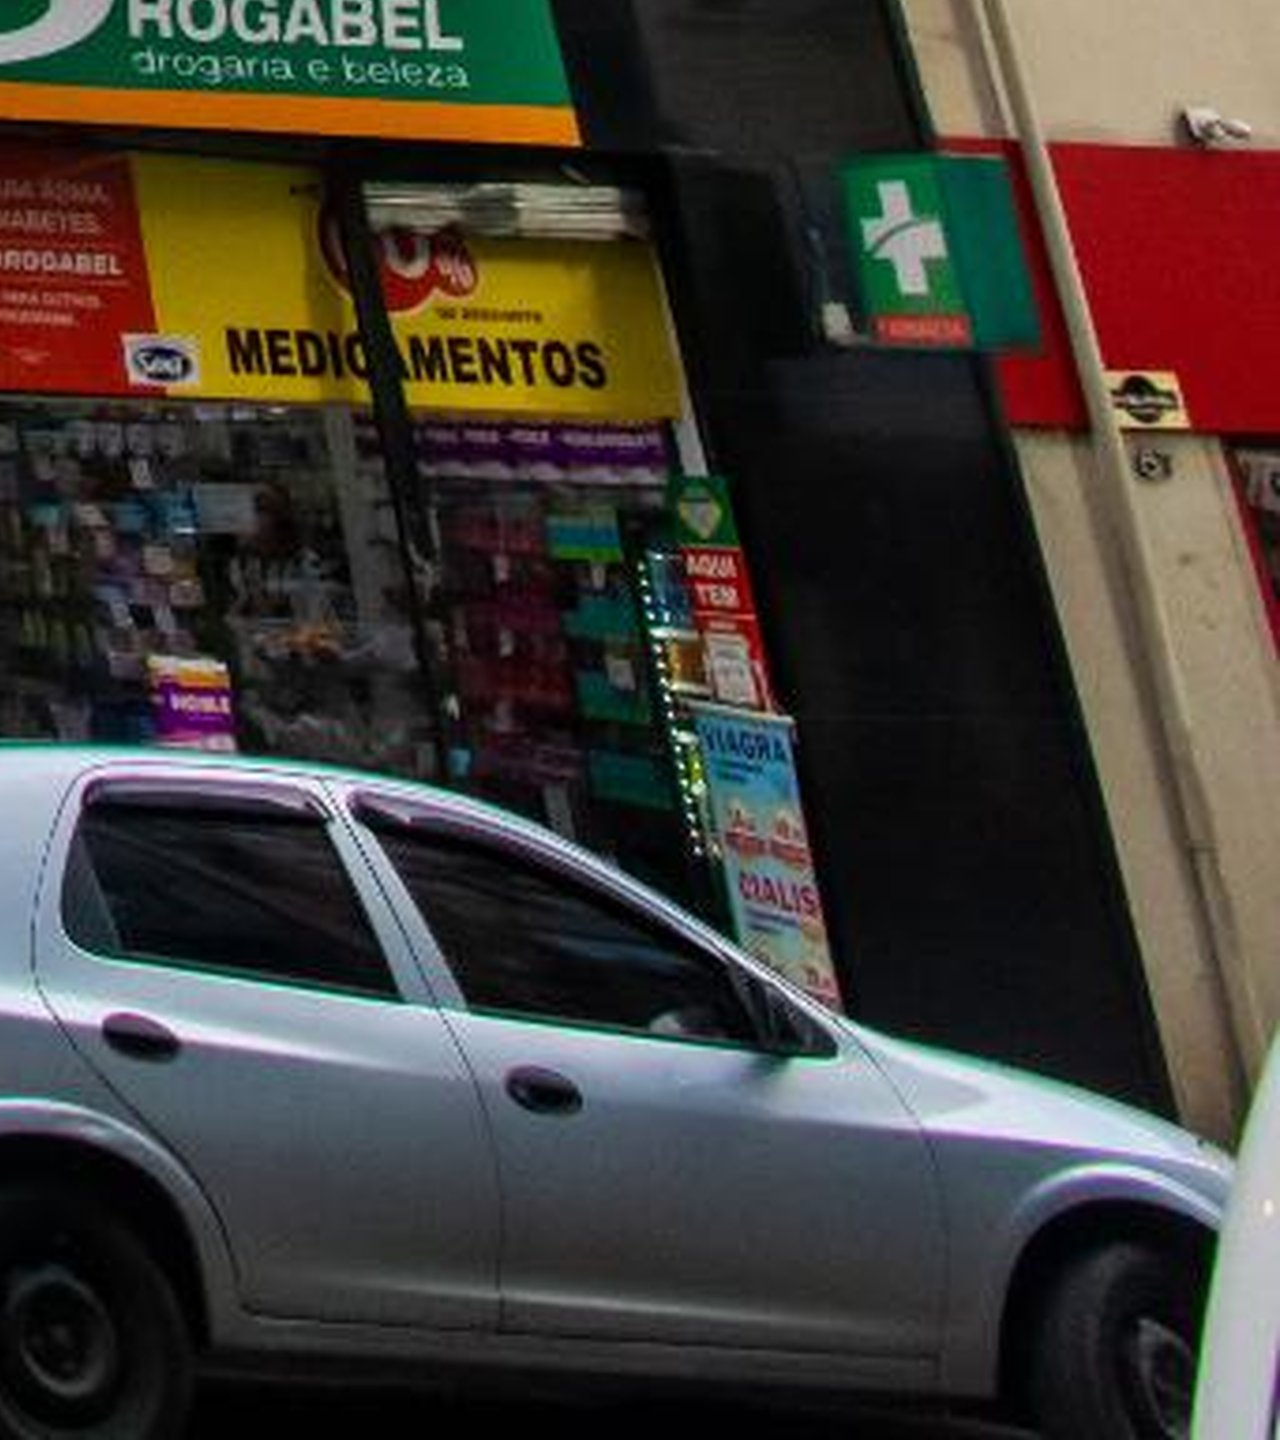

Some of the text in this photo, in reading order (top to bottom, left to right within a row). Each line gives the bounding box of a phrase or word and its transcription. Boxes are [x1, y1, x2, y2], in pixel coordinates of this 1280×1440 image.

[131, 49, 470, 90] drogaria e beleza
[225, 326, 608, 390] MEDICMENTOS
[686, 553, 737, 579] AQUI
[694, 581, 740, 608] TEM
[703, 725, 789, 762] VIAGRA
[739, 871, 820, 916] CIALIS
